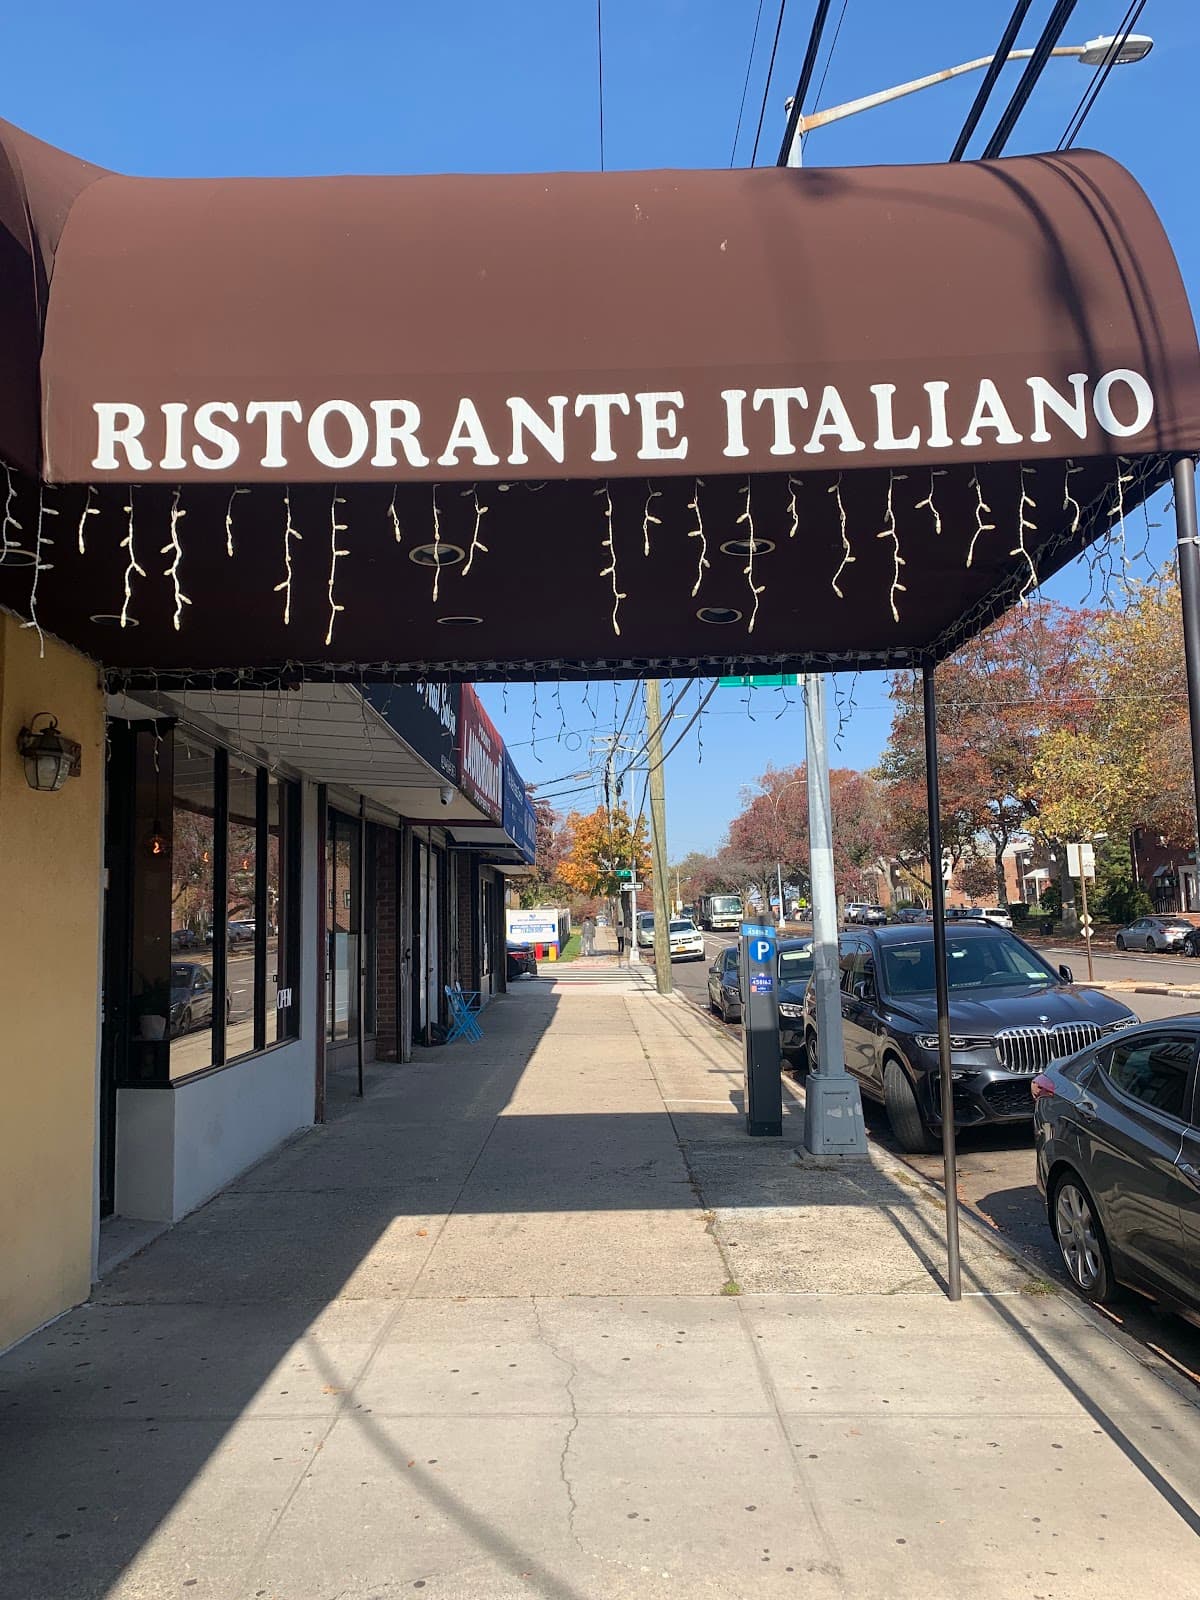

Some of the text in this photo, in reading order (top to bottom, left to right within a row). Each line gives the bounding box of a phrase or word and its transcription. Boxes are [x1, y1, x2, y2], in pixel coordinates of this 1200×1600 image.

[91, 369, 1154, 470] RISTORANTE ITALIANO
[757, 941, 770, 960] P
[277, 988, 292, 1009] OPEN
